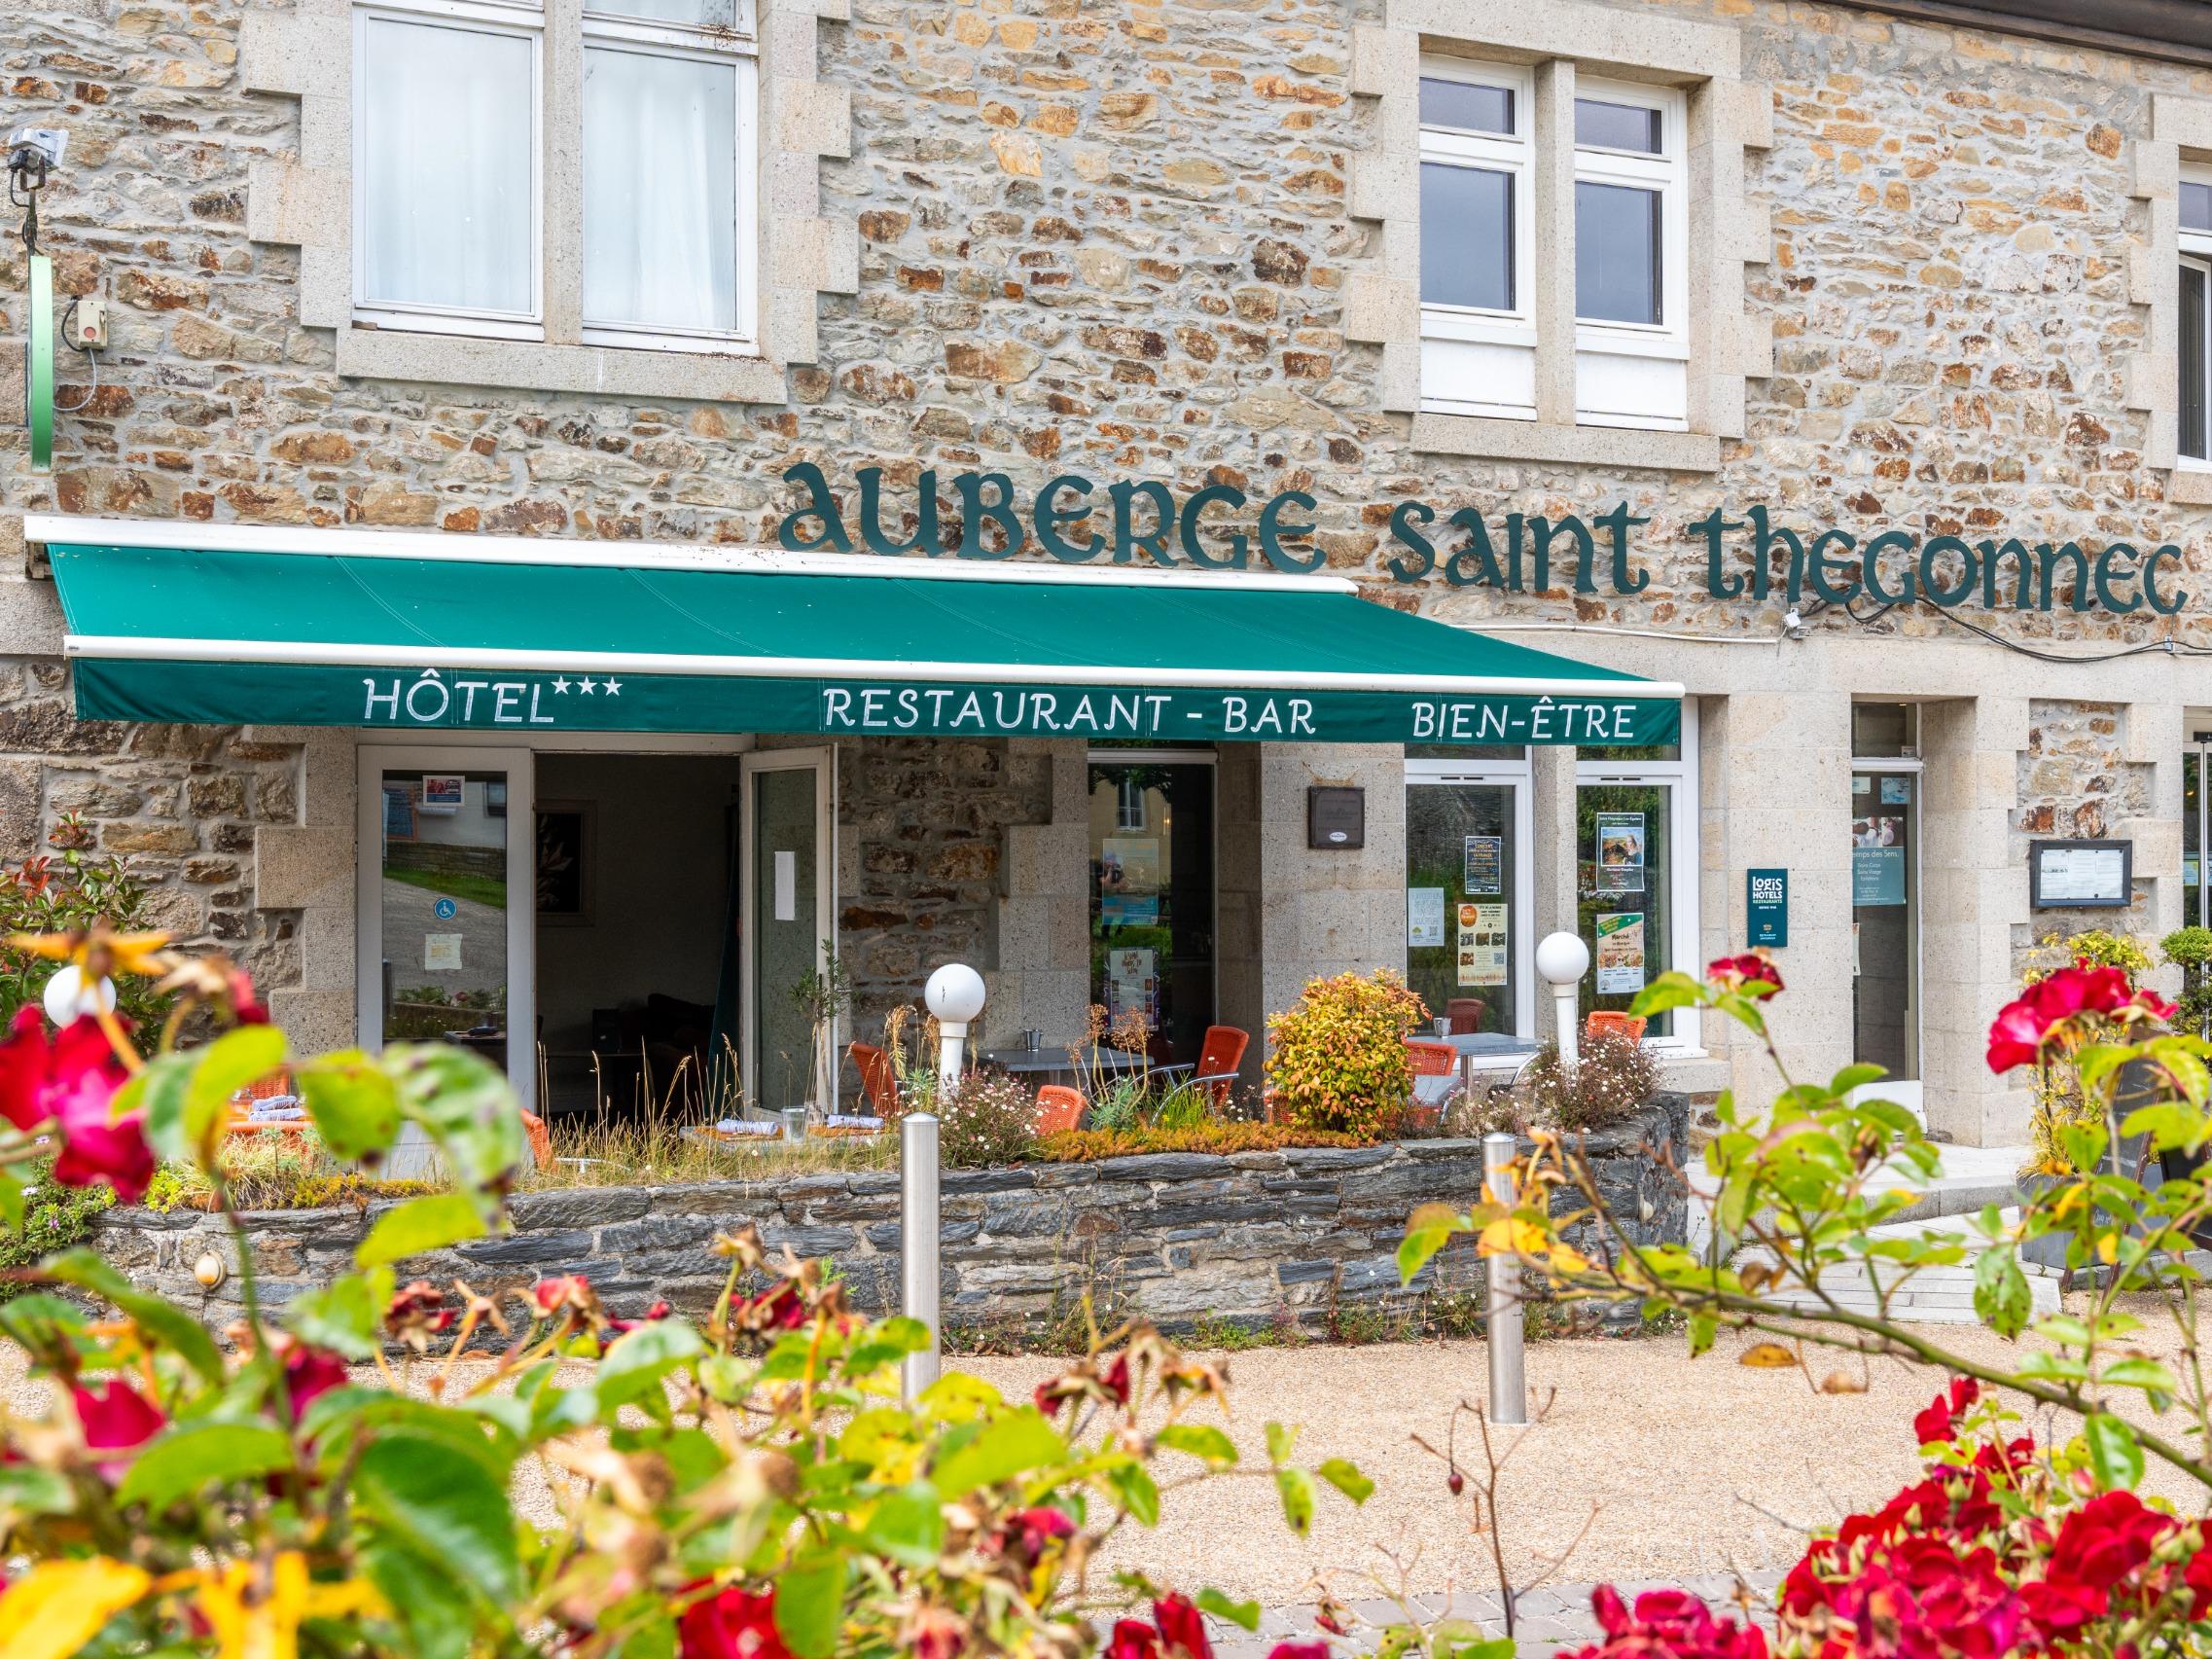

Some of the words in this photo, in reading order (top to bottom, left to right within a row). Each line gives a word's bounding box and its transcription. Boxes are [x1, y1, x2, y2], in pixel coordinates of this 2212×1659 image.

[362, 667, 554, 723] HÔTEL
[823, 688, 1172, 732] RESTAURANT
[1222, 697, 1316, 735] BAR
[1411, 695, 1636, 739] BIEN-ÊTRE
